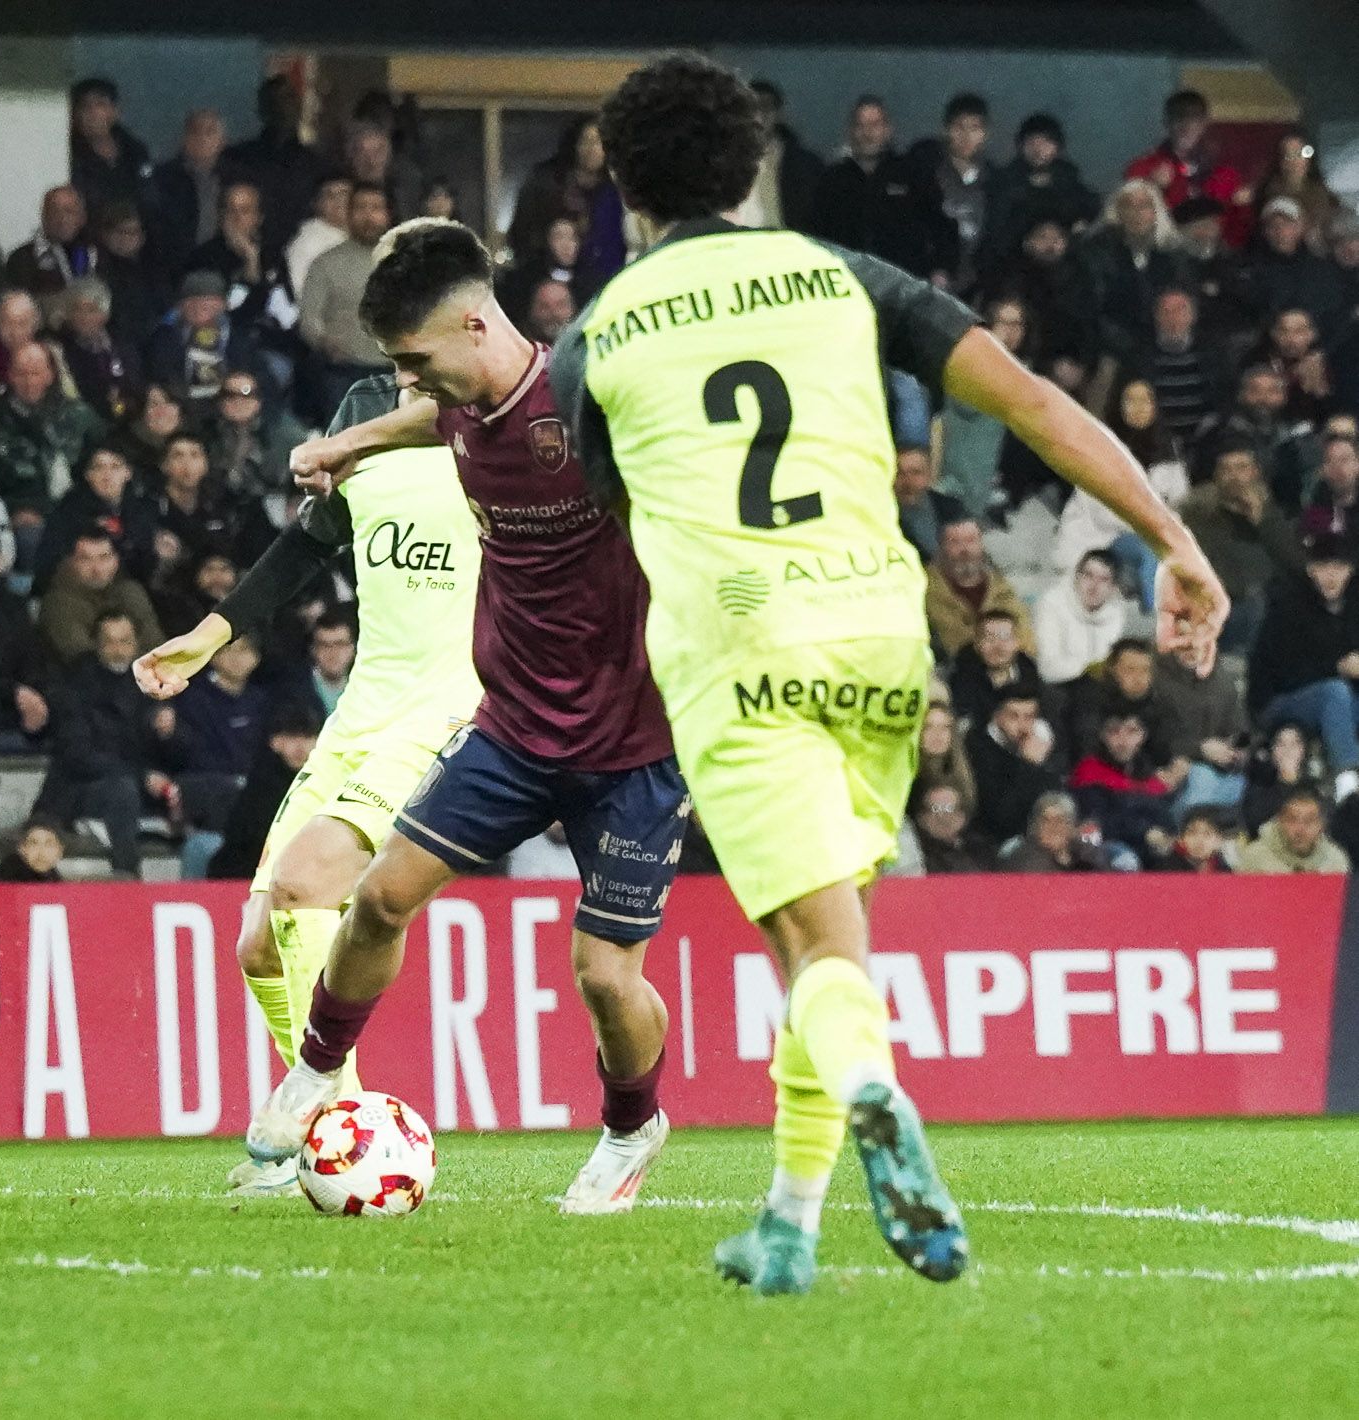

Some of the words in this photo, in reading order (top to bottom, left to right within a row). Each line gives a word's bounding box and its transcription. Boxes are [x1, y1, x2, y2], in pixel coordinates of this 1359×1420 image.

[595, 289, 714, 360] MATEU
[729, 267, 851, 316] JAUME
[703, 359, 823, 530] 2
[407, 576, 421, 592] by
[784, 547, 913, 584] ALUA
[734, 673, 922, 718] Menorca
[606, 893, 647, 908] GALEGO
[608, 881, 653, 896] DEPORTE
[428, 896, 584, 1131] RE
